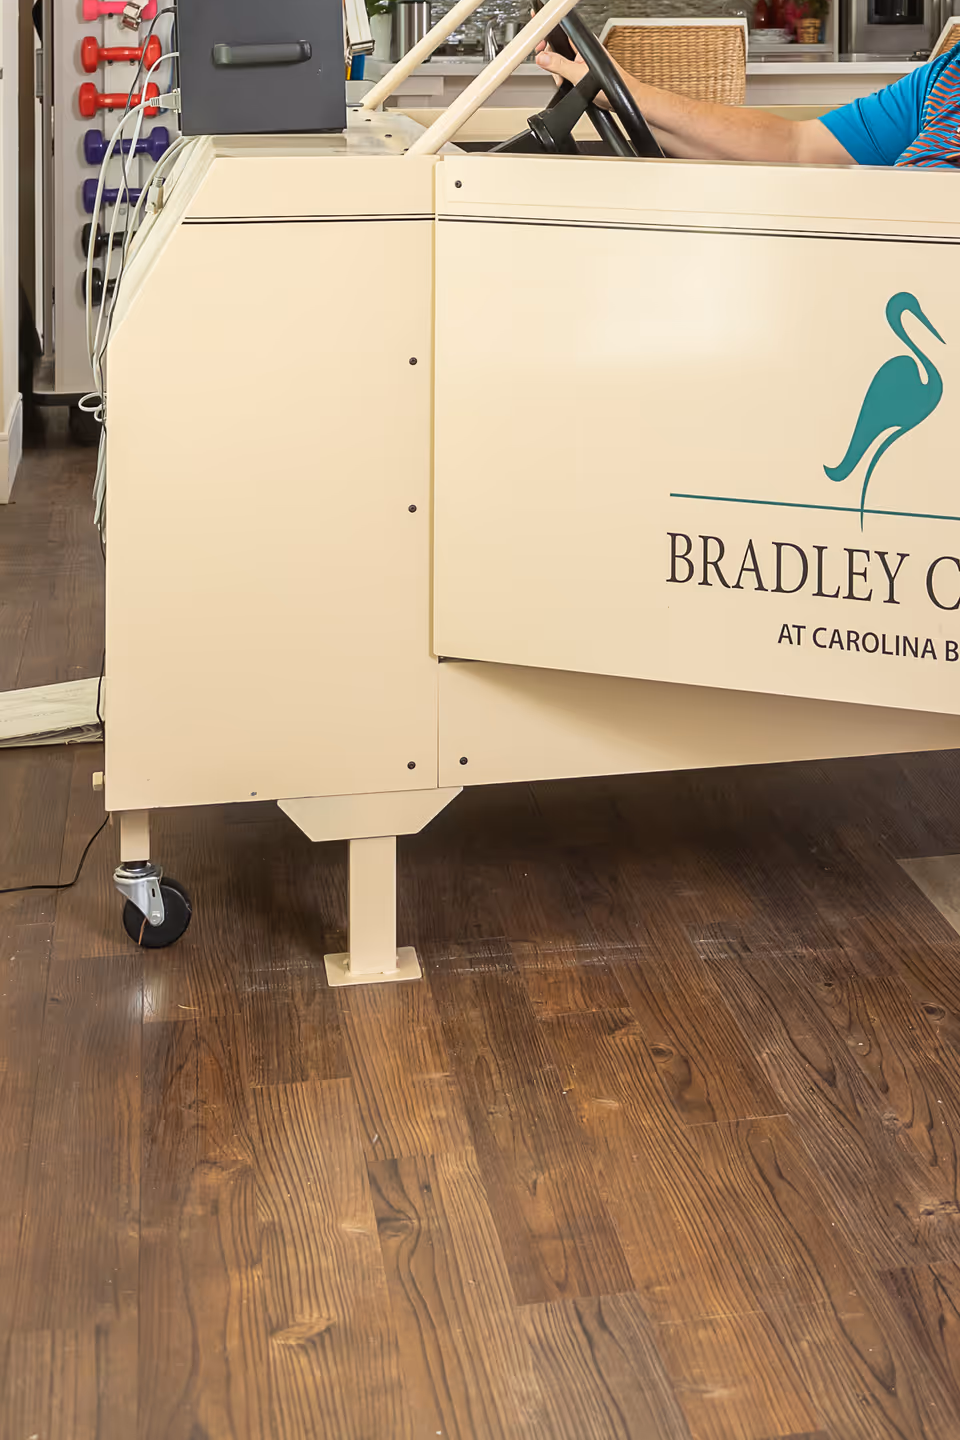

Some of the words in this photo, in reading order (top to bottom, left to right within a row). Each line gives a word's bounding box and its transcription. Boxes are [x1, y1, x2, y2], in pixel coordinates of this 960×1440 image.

[665, 532, 910, 605] BRADLEY
[777, 623, 807, 646] AT
[812, 627, 938, 660] CAROLINA
